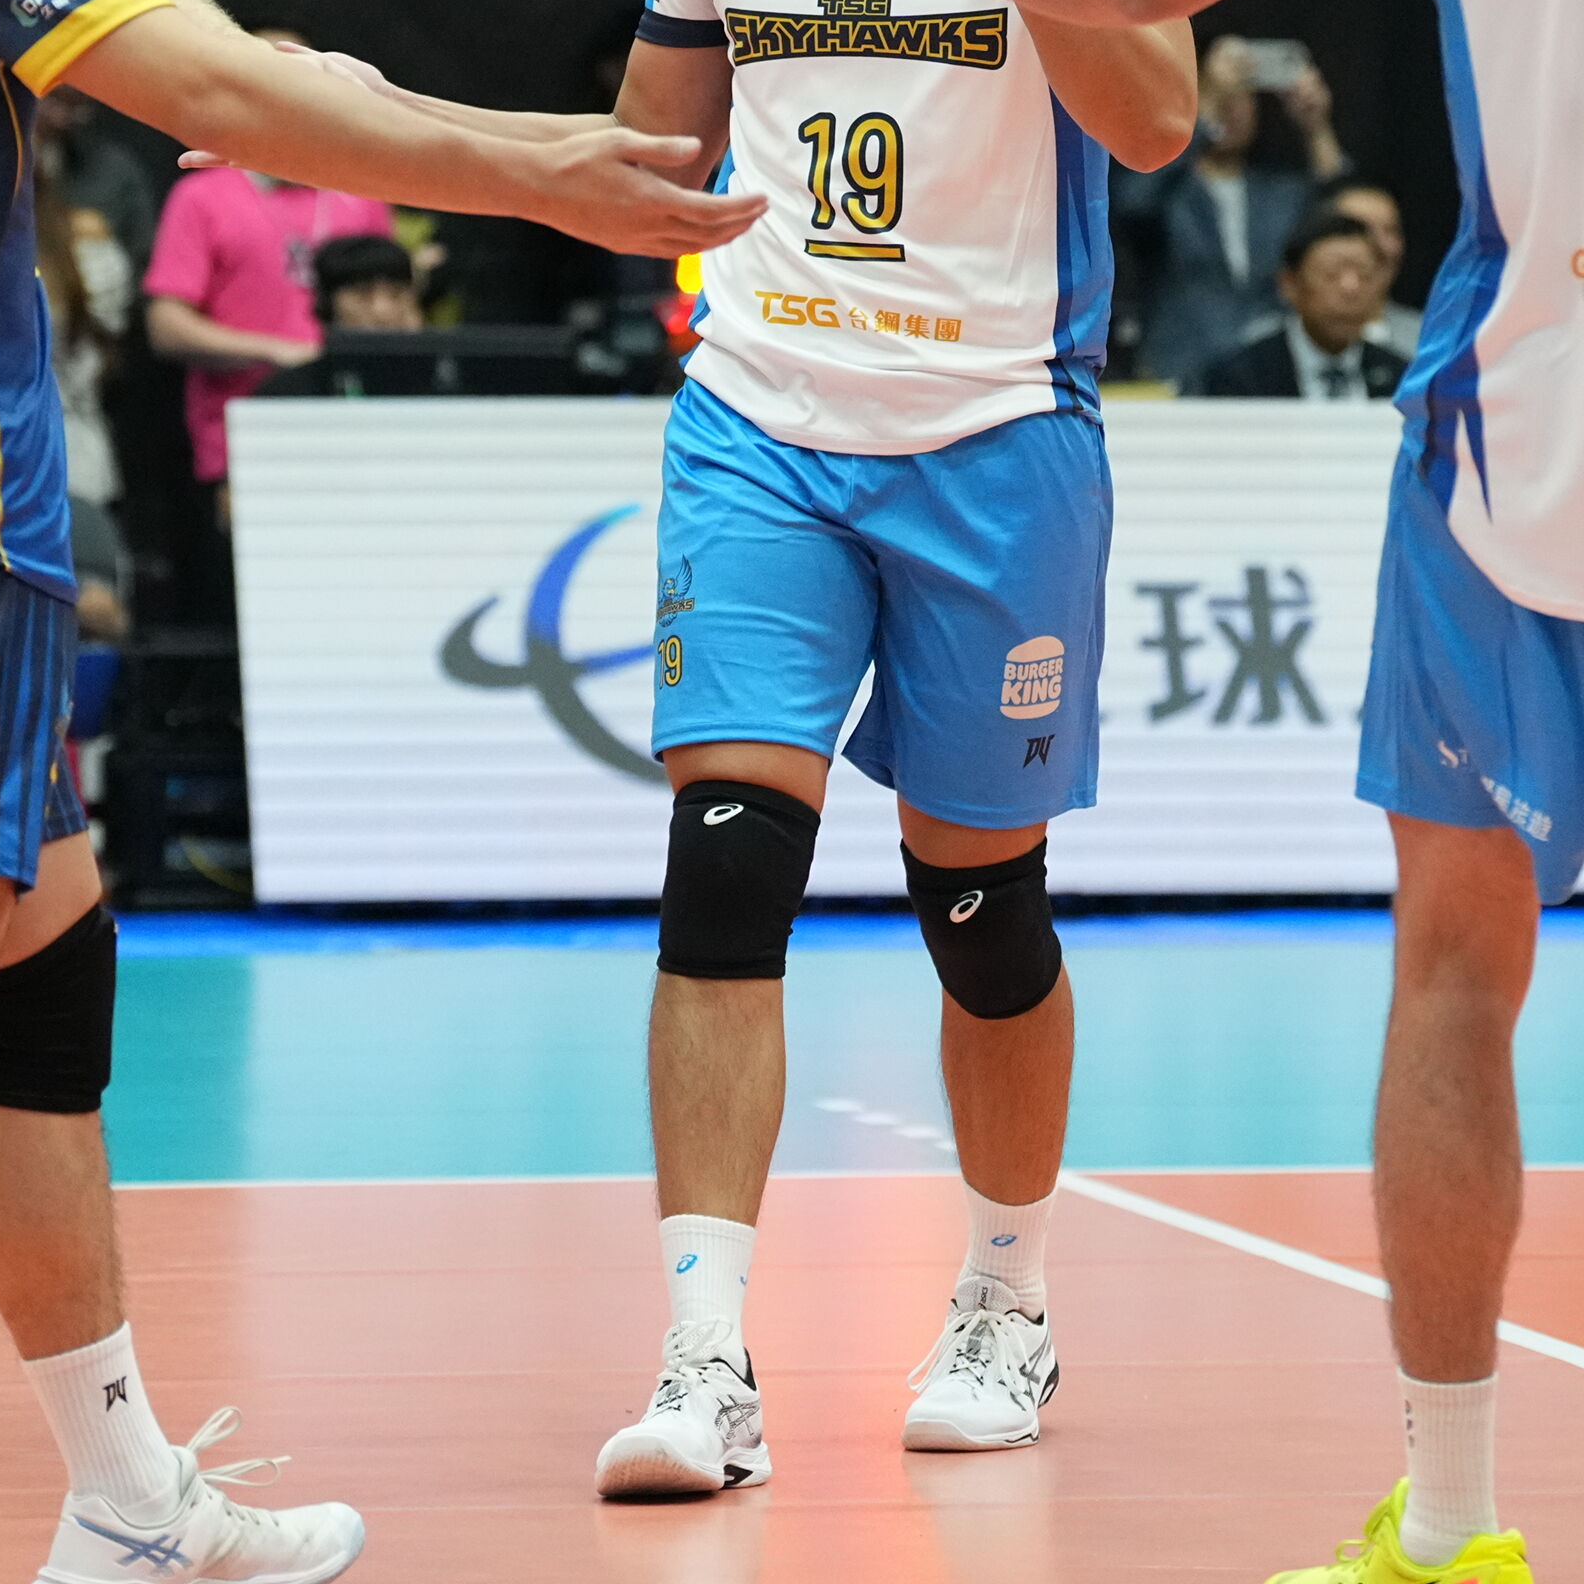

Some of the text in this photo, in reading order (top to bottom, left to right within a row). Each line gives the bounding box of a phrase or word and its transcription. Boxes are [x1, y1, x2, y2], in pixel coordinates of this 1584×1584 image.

[727, 8, 1007, 69] SKYHAWKS
[798, 111, 903, 234] 19
[755, 289, 962, 343] TSG 台鋼集團
[657, 634, 683, 690] 19
[1003, 657, 1064, 681] BURGER
[1000, 675, 1063, 706] KING
